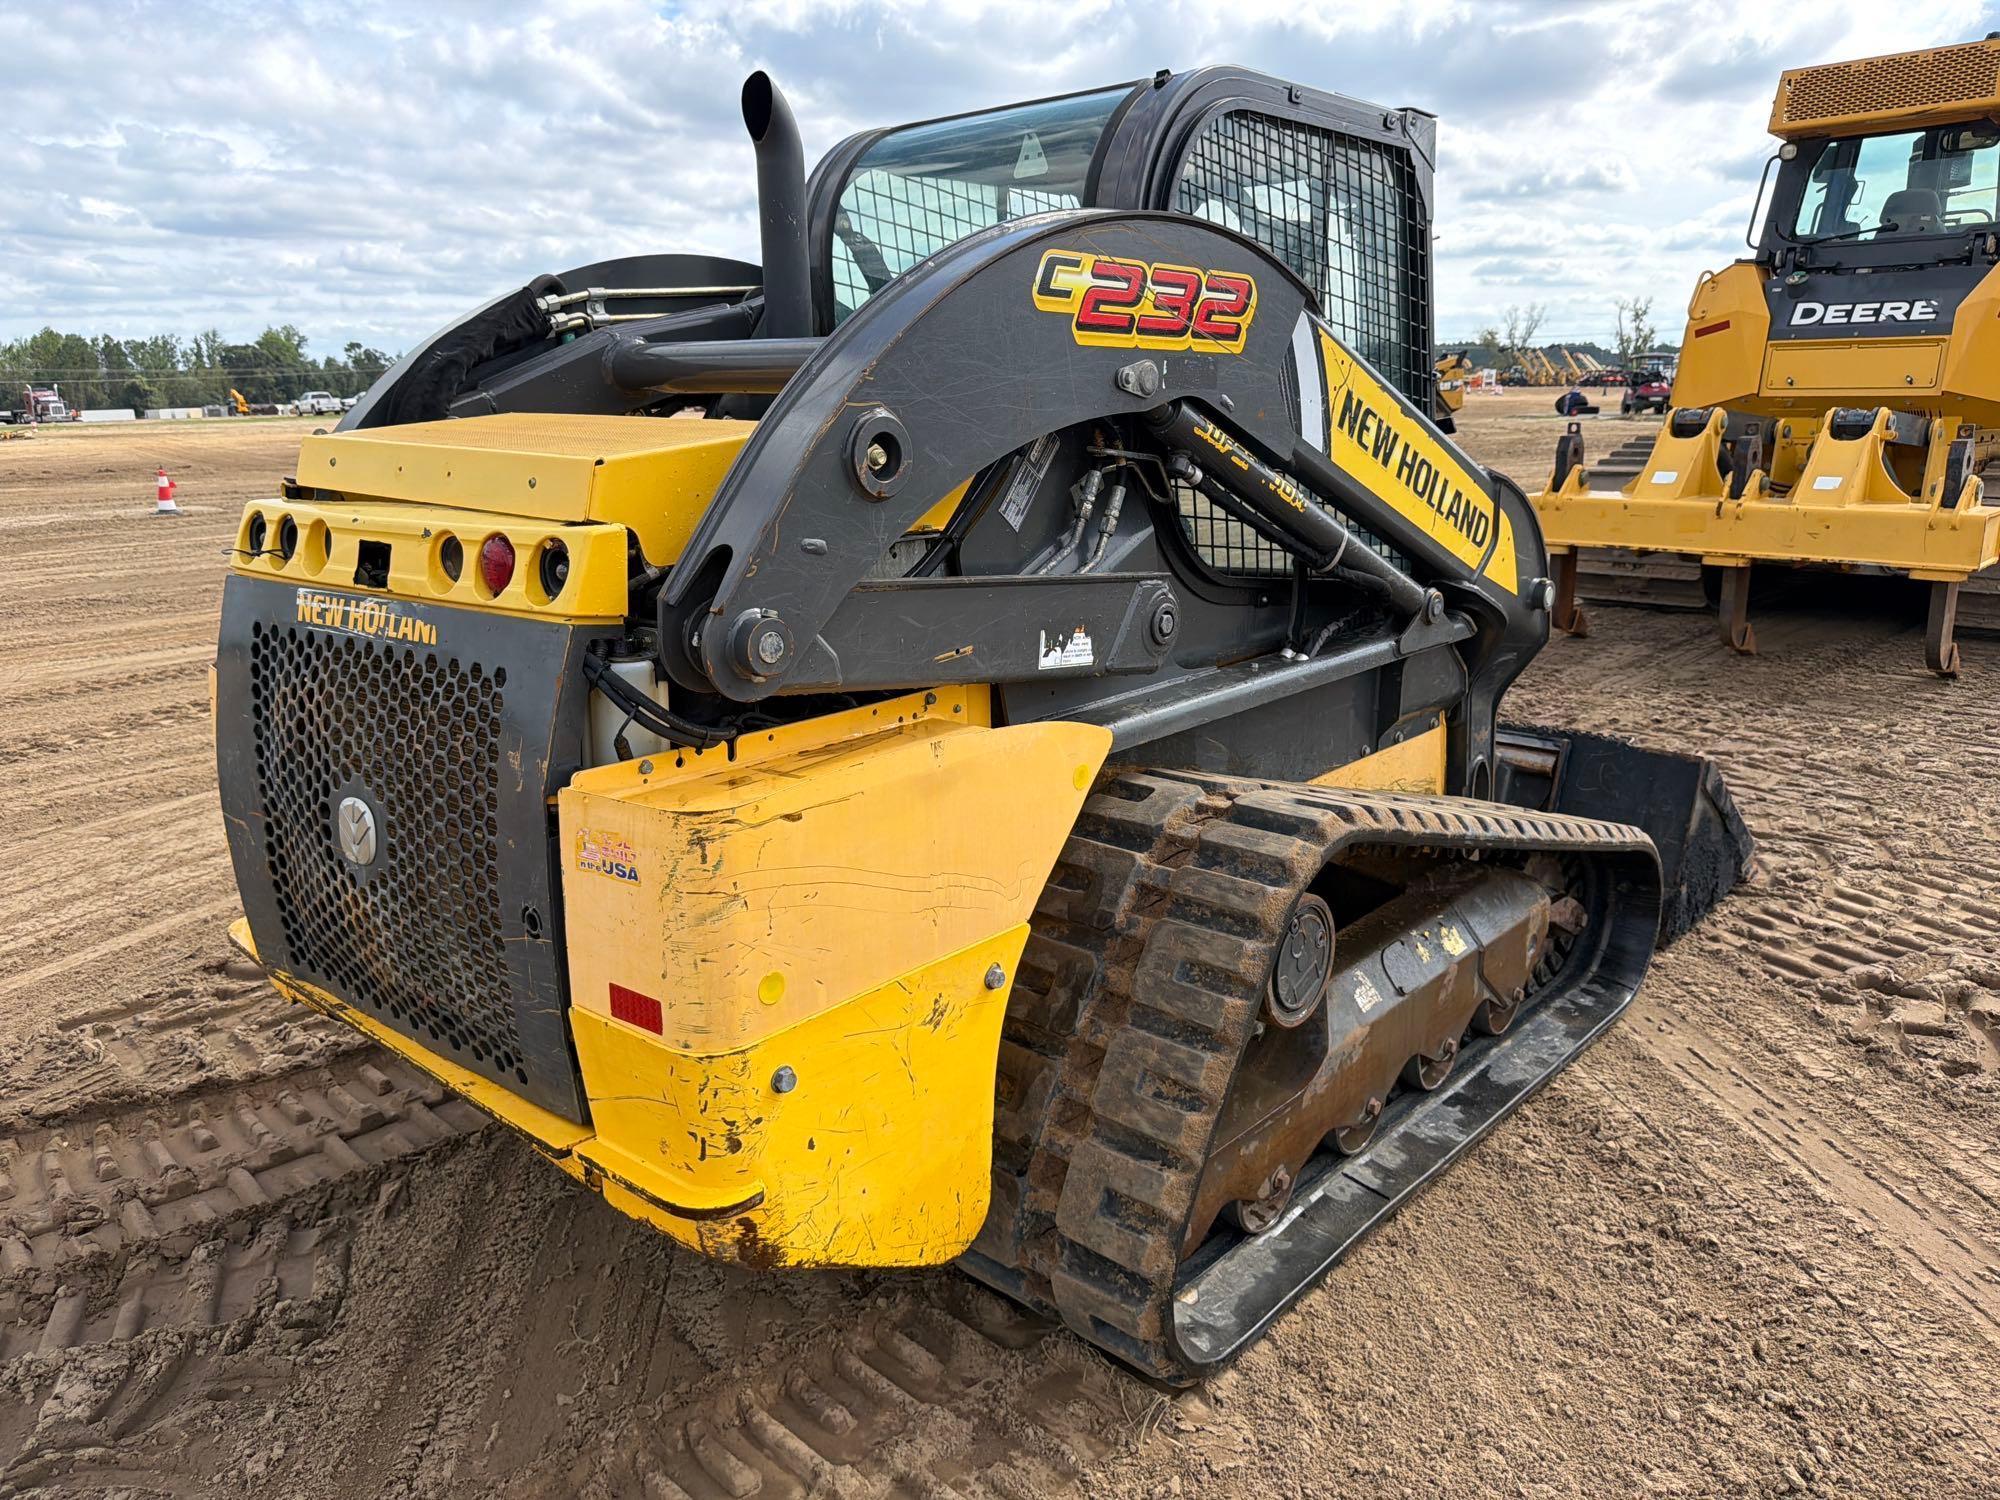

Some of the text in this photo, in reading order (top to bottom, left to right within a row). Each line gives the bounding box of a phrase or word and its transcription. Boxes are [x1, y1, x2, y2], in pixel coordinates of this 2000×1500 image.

[1036, 253, 1253, 343] C232
[1790, 301, 1939, 326] DEERE
[1337, 388, 1490, 549] NEW HOLLAND
[297, 593, 345, 628] NEW
[602, 859, 639, 881] USA
